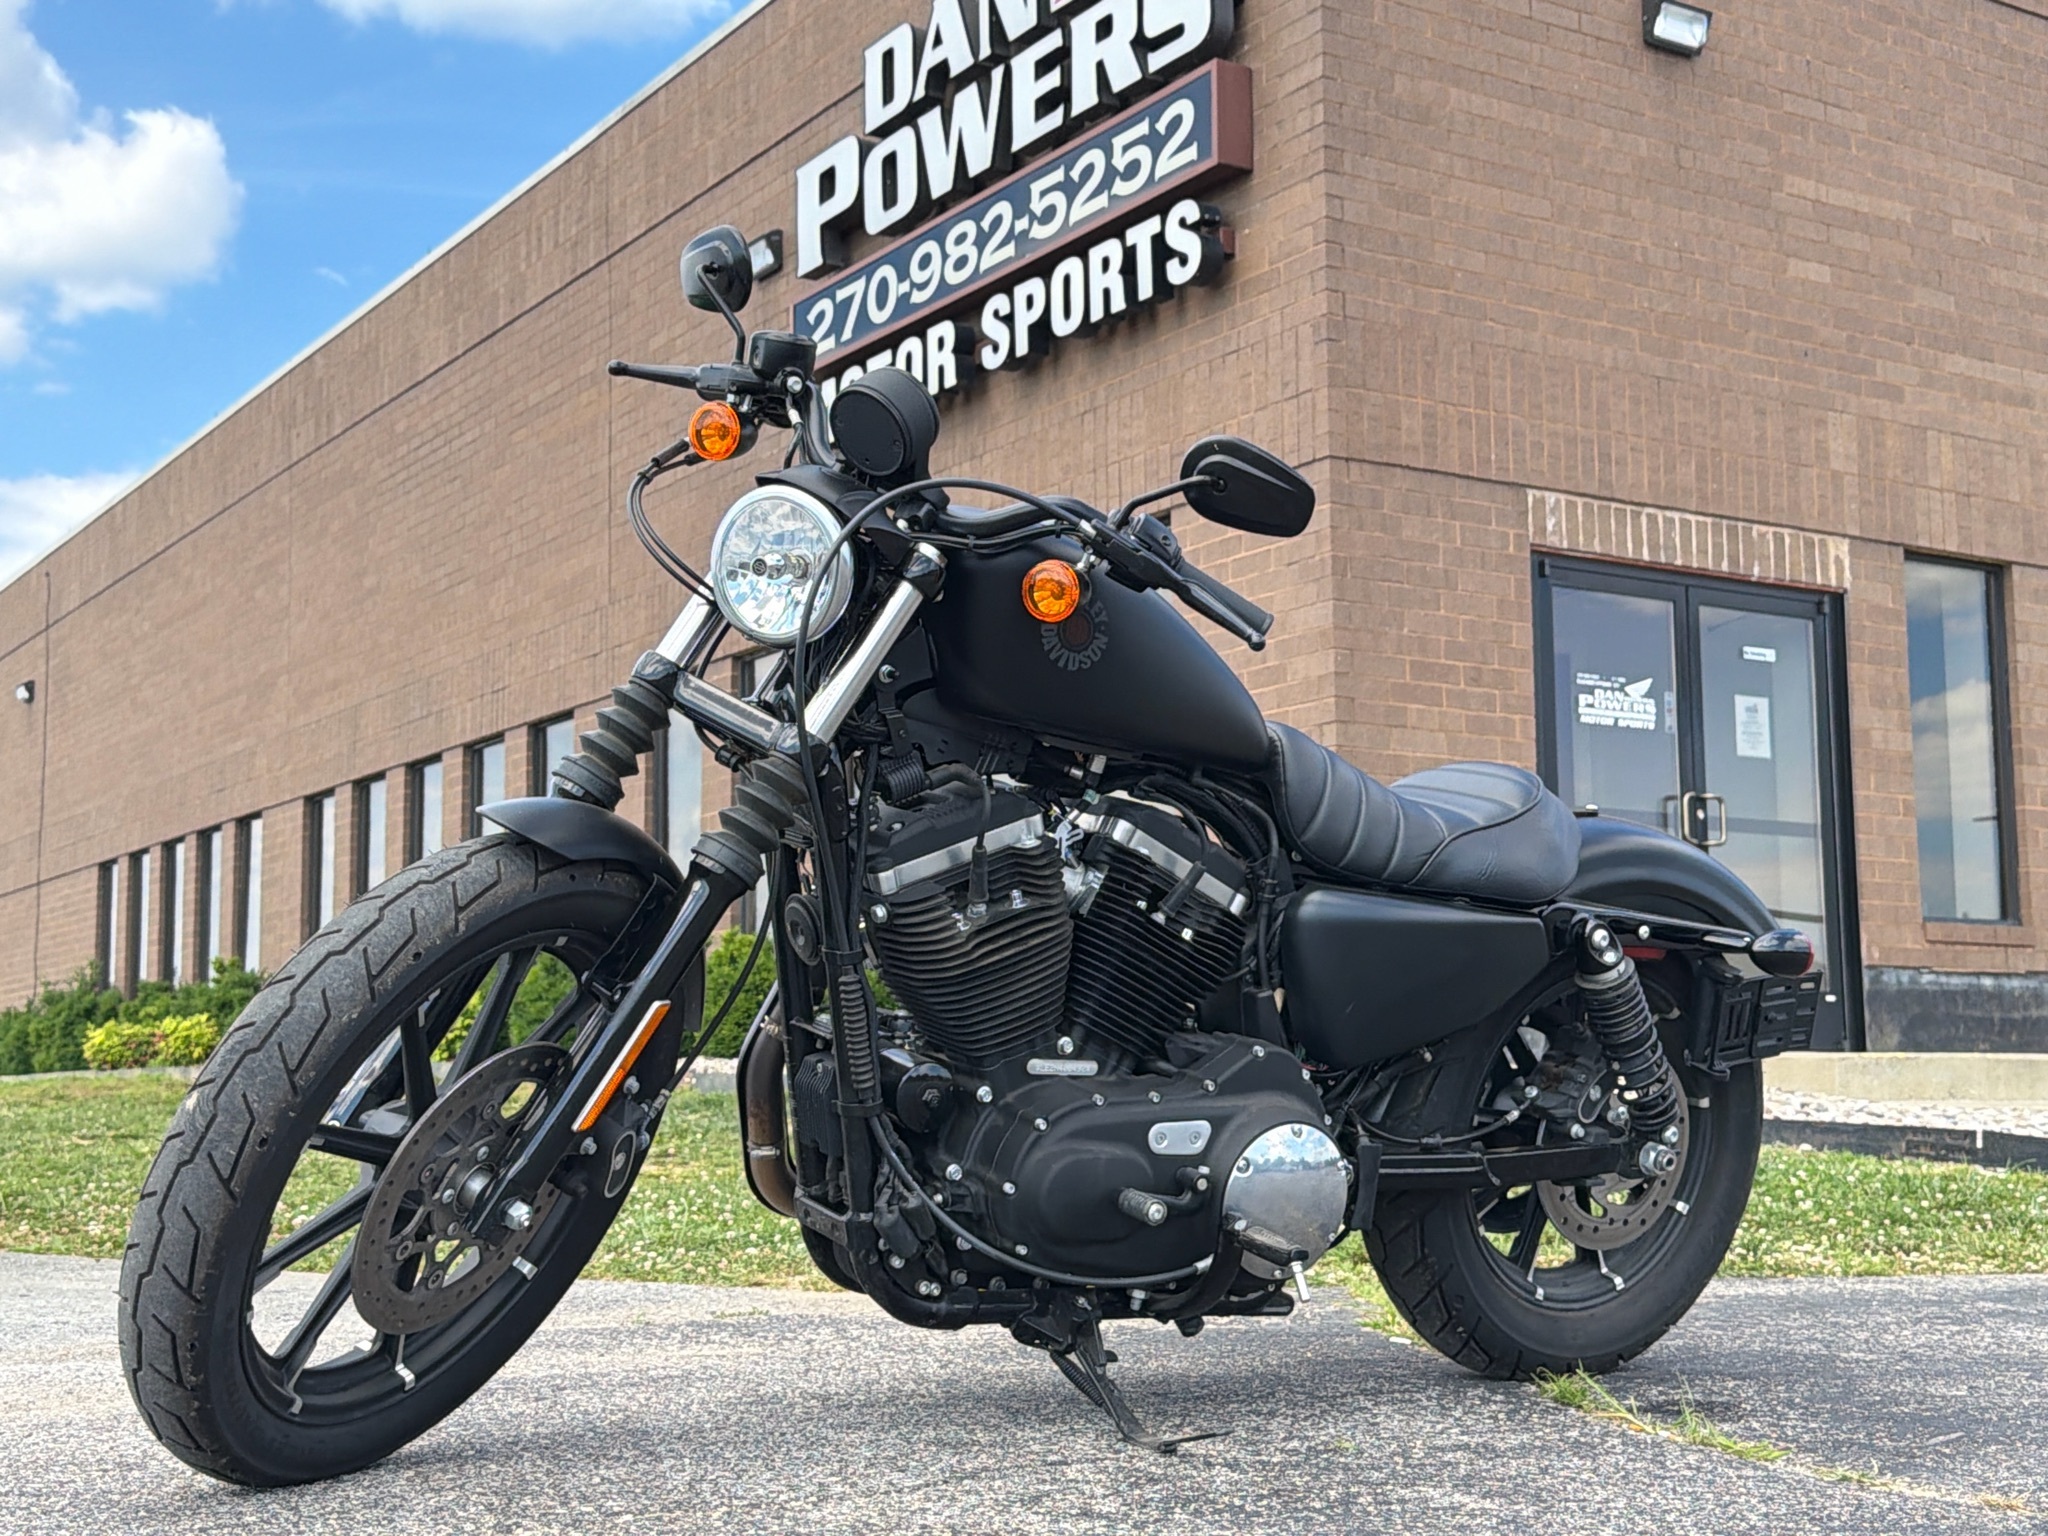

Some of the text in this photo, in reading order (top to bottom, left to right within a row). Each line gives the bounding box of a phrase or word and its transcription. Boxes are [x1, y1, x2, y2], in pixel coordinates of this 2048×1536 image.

[796, 0, 1211, 279] POWERS
[806, 98, 1198, 356] 270-982-5252
[981, 199, 1201, 371] SPORTS
